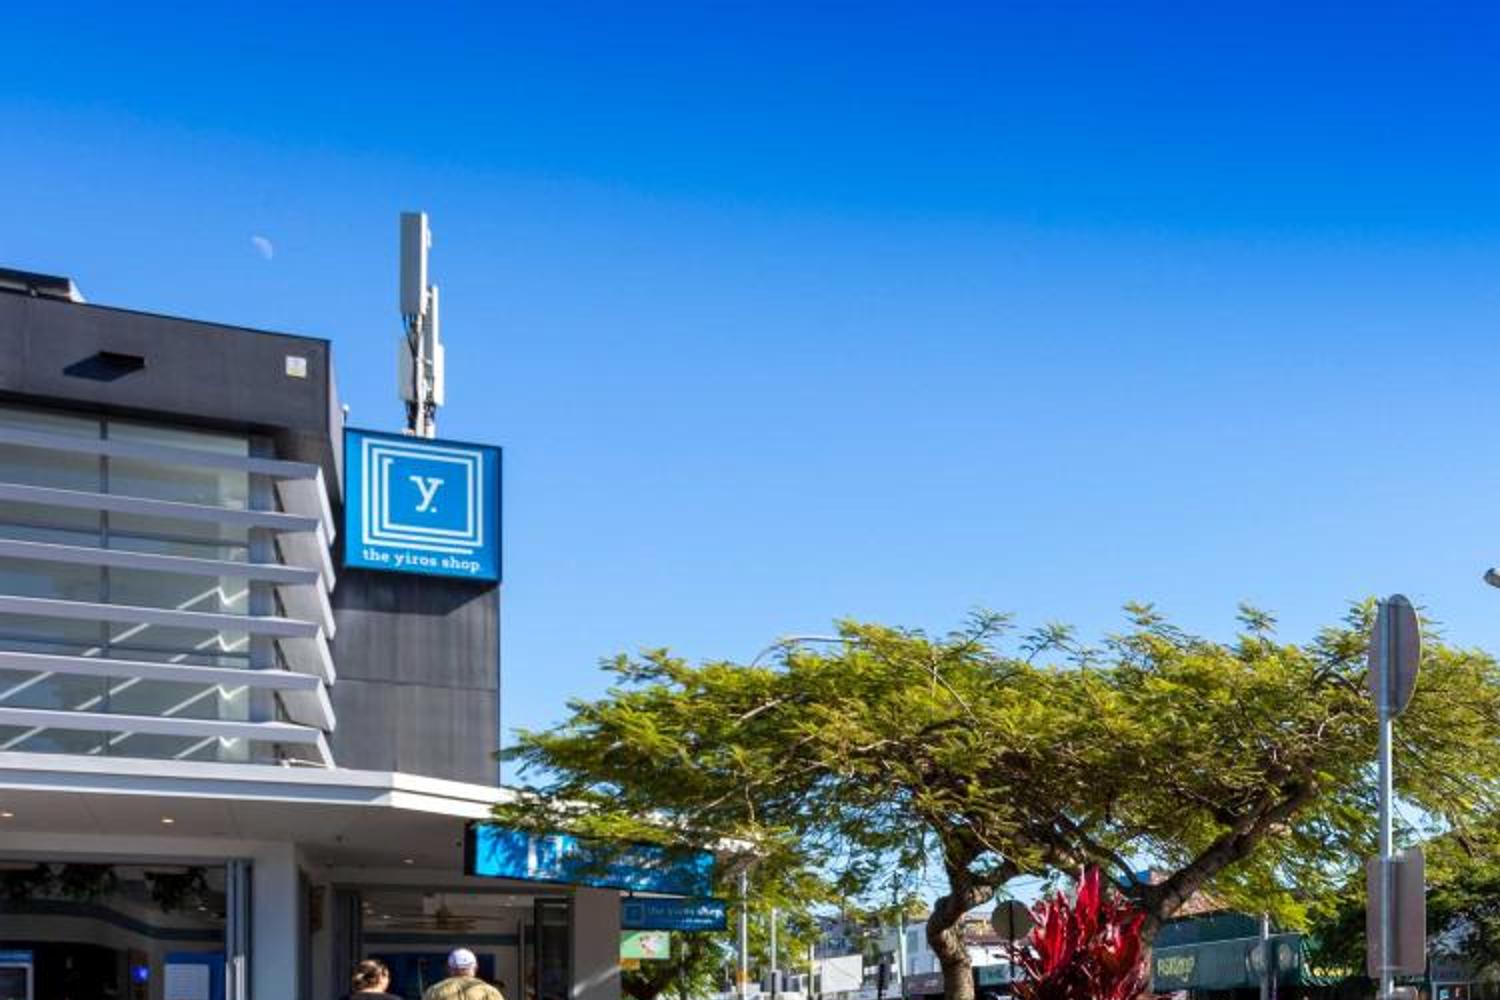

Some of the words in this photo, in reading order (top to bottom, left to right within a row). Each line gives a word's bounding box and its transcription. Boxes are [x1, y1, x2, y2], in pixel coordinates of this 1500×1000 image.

[362, 548, 390, 562] the
[394, 551, 438, 567] yiros
[441, 556, 480, 575] shop
